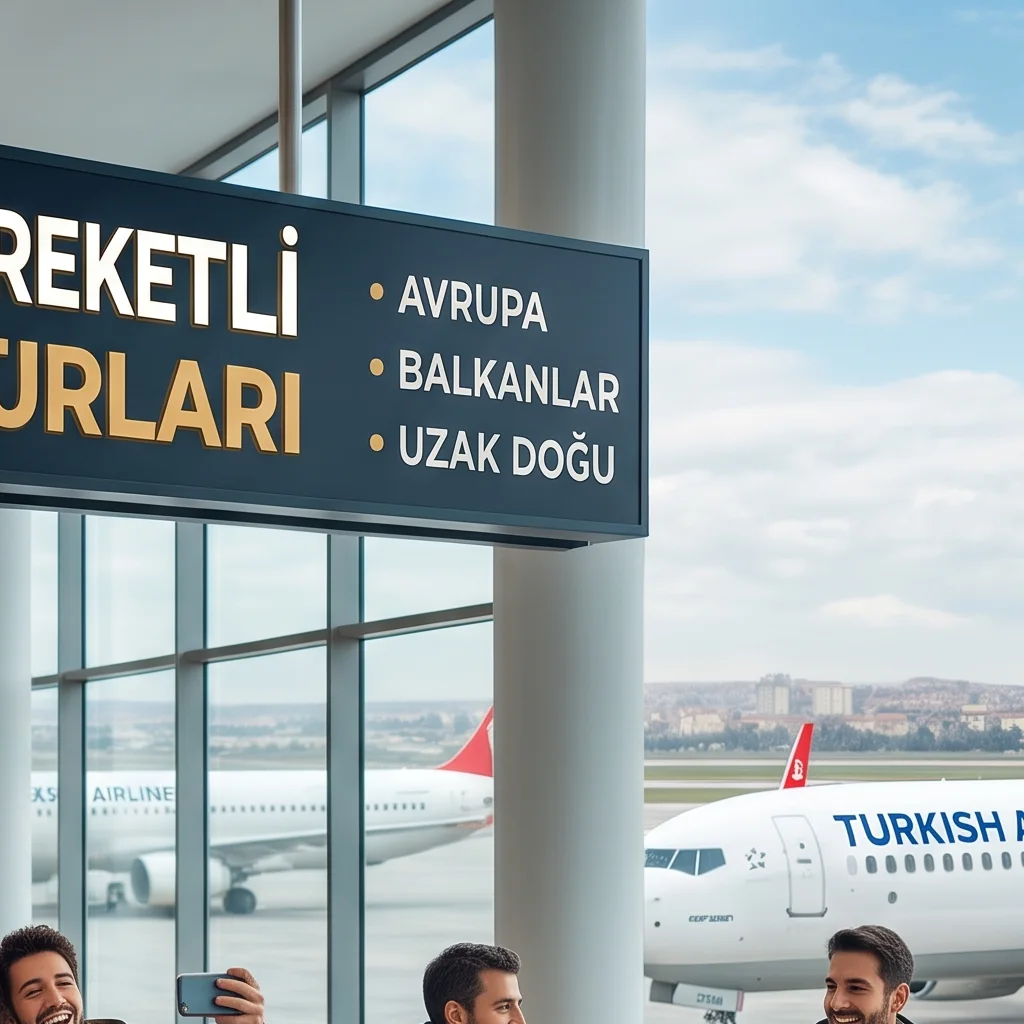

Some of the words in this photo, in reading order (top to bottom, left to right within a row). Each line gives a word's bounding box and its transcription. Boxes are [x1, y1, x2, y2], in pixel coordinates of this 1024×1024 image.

[397, 274, 548, 333] AVRUPA
[399, 349, 620, 414] BALKANLAR
[399, 424, 501, 474] UZAK
[512, 430, 615, 485] DOĞU
[833, 811, 1006, 847] TURKISH
